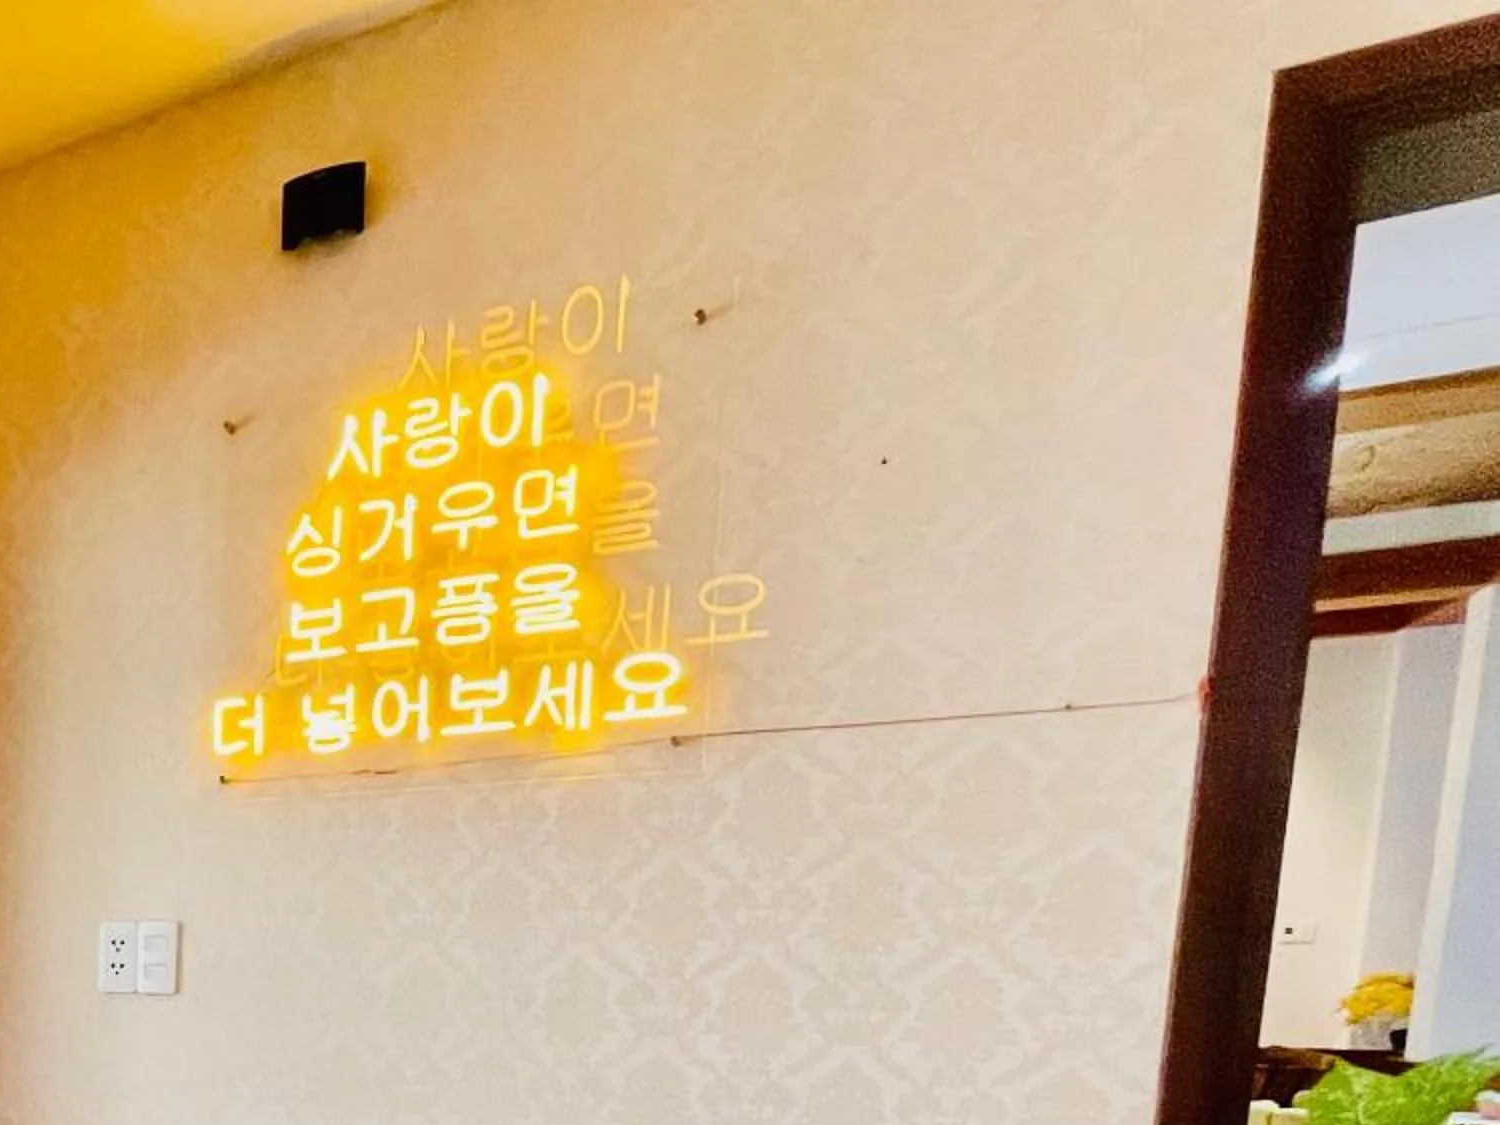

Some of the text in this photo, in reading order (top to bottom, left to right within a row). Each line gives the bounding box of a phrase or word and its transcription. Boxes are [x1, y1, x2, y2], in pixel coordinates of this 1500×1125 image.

[326, 373, 553, 480] 사랑이
[285, 464, 580, 577] 싱거우면
[283, 562, 582, 664] 보고픔을
[211, 693, 266, 757] 더
[300, 652, 689, 757] 넣어보세요
